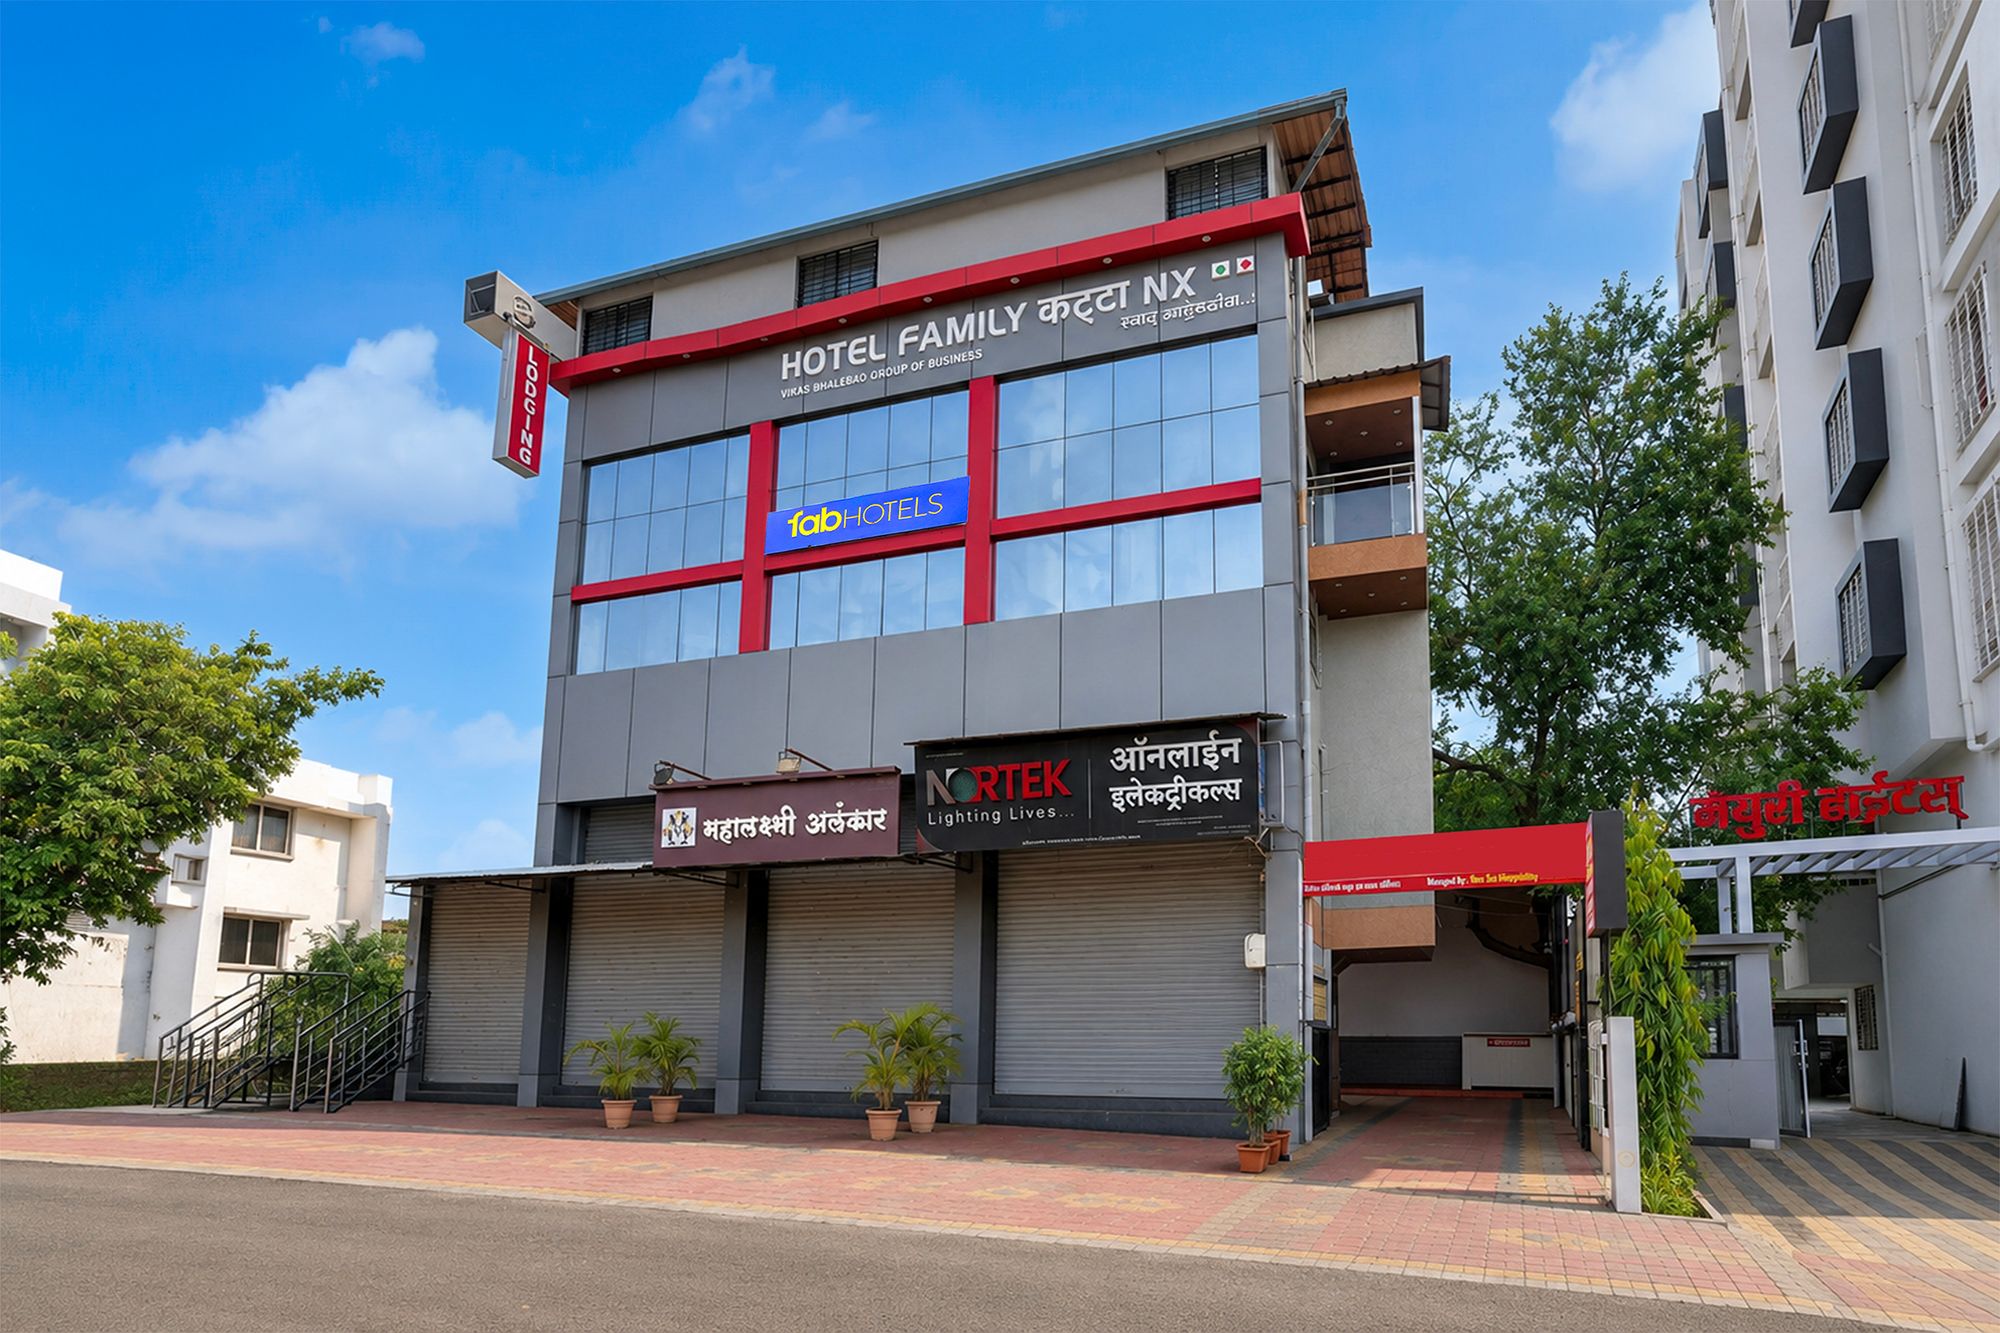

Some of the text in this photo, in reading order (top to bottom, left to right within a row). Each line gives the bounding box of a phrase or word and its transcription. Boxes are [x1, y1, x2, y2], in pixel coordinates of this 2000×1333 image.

[781, 266, 1197, 380] HOTEL FAMILY कट्टा NX
[780, 384, 810, 399] VIKAS
[911, 360, 926, 372] OF
[928, 348, 983, 370] BUSINESS
[518, 345, 539, 465] LODGING
[1109, 729, 1242, 772] ऑनलाईन
[926, 758, 1072, 806] NORTEK
[703, 801, 888, 844] महालक्ष्मी अलंकार
[928, 808, 1001, 827] Lighting
